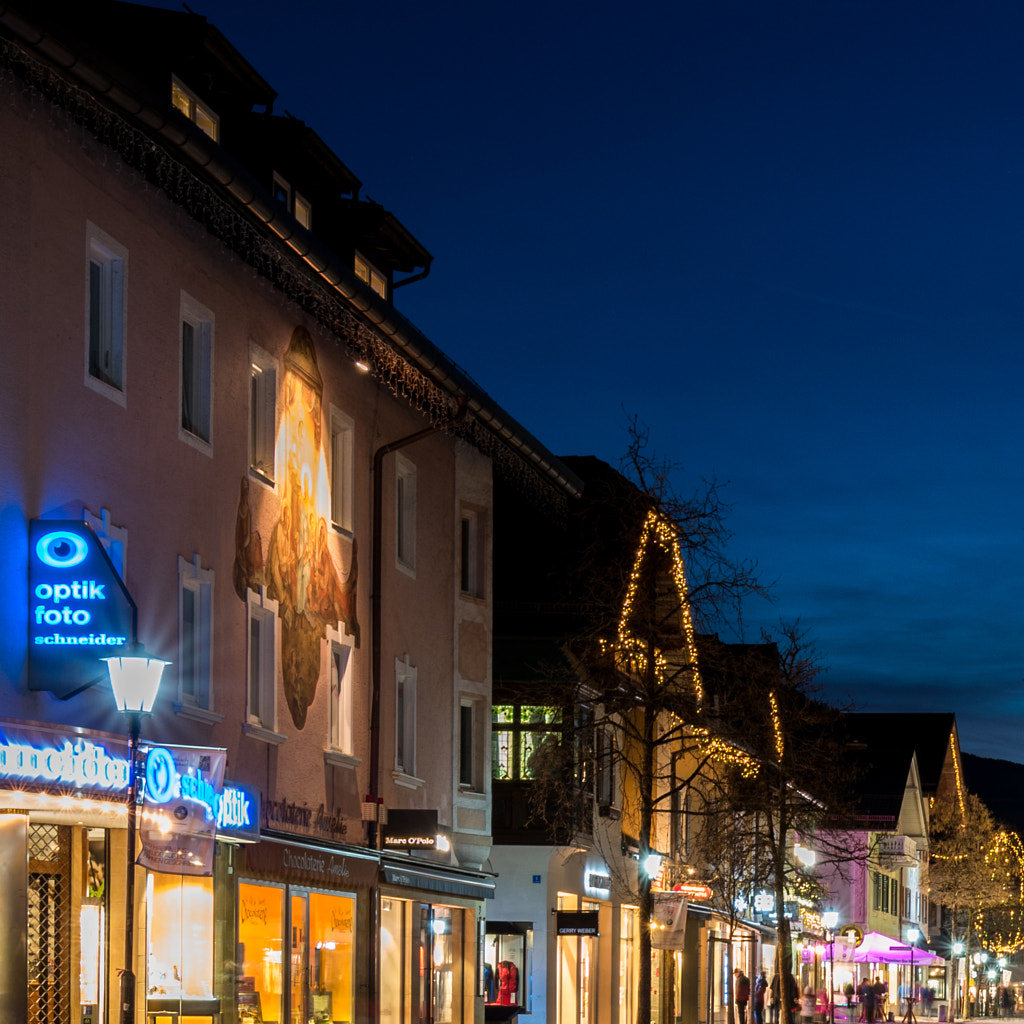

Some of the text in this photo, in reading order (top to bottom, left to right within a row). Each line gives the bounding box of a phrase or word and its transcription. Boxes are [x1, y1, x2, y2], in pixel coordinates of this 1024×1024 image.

[35, 580, 106, 603] optik
[34, 605, 91, 625] foto
[34, 633, 126, 645] schneider
[384, 837, 435, 845] Marc O'Polo
[282, 848, 325, 873] Chocolaterie
[559, 927, 597, 935] GERRY WEBER
